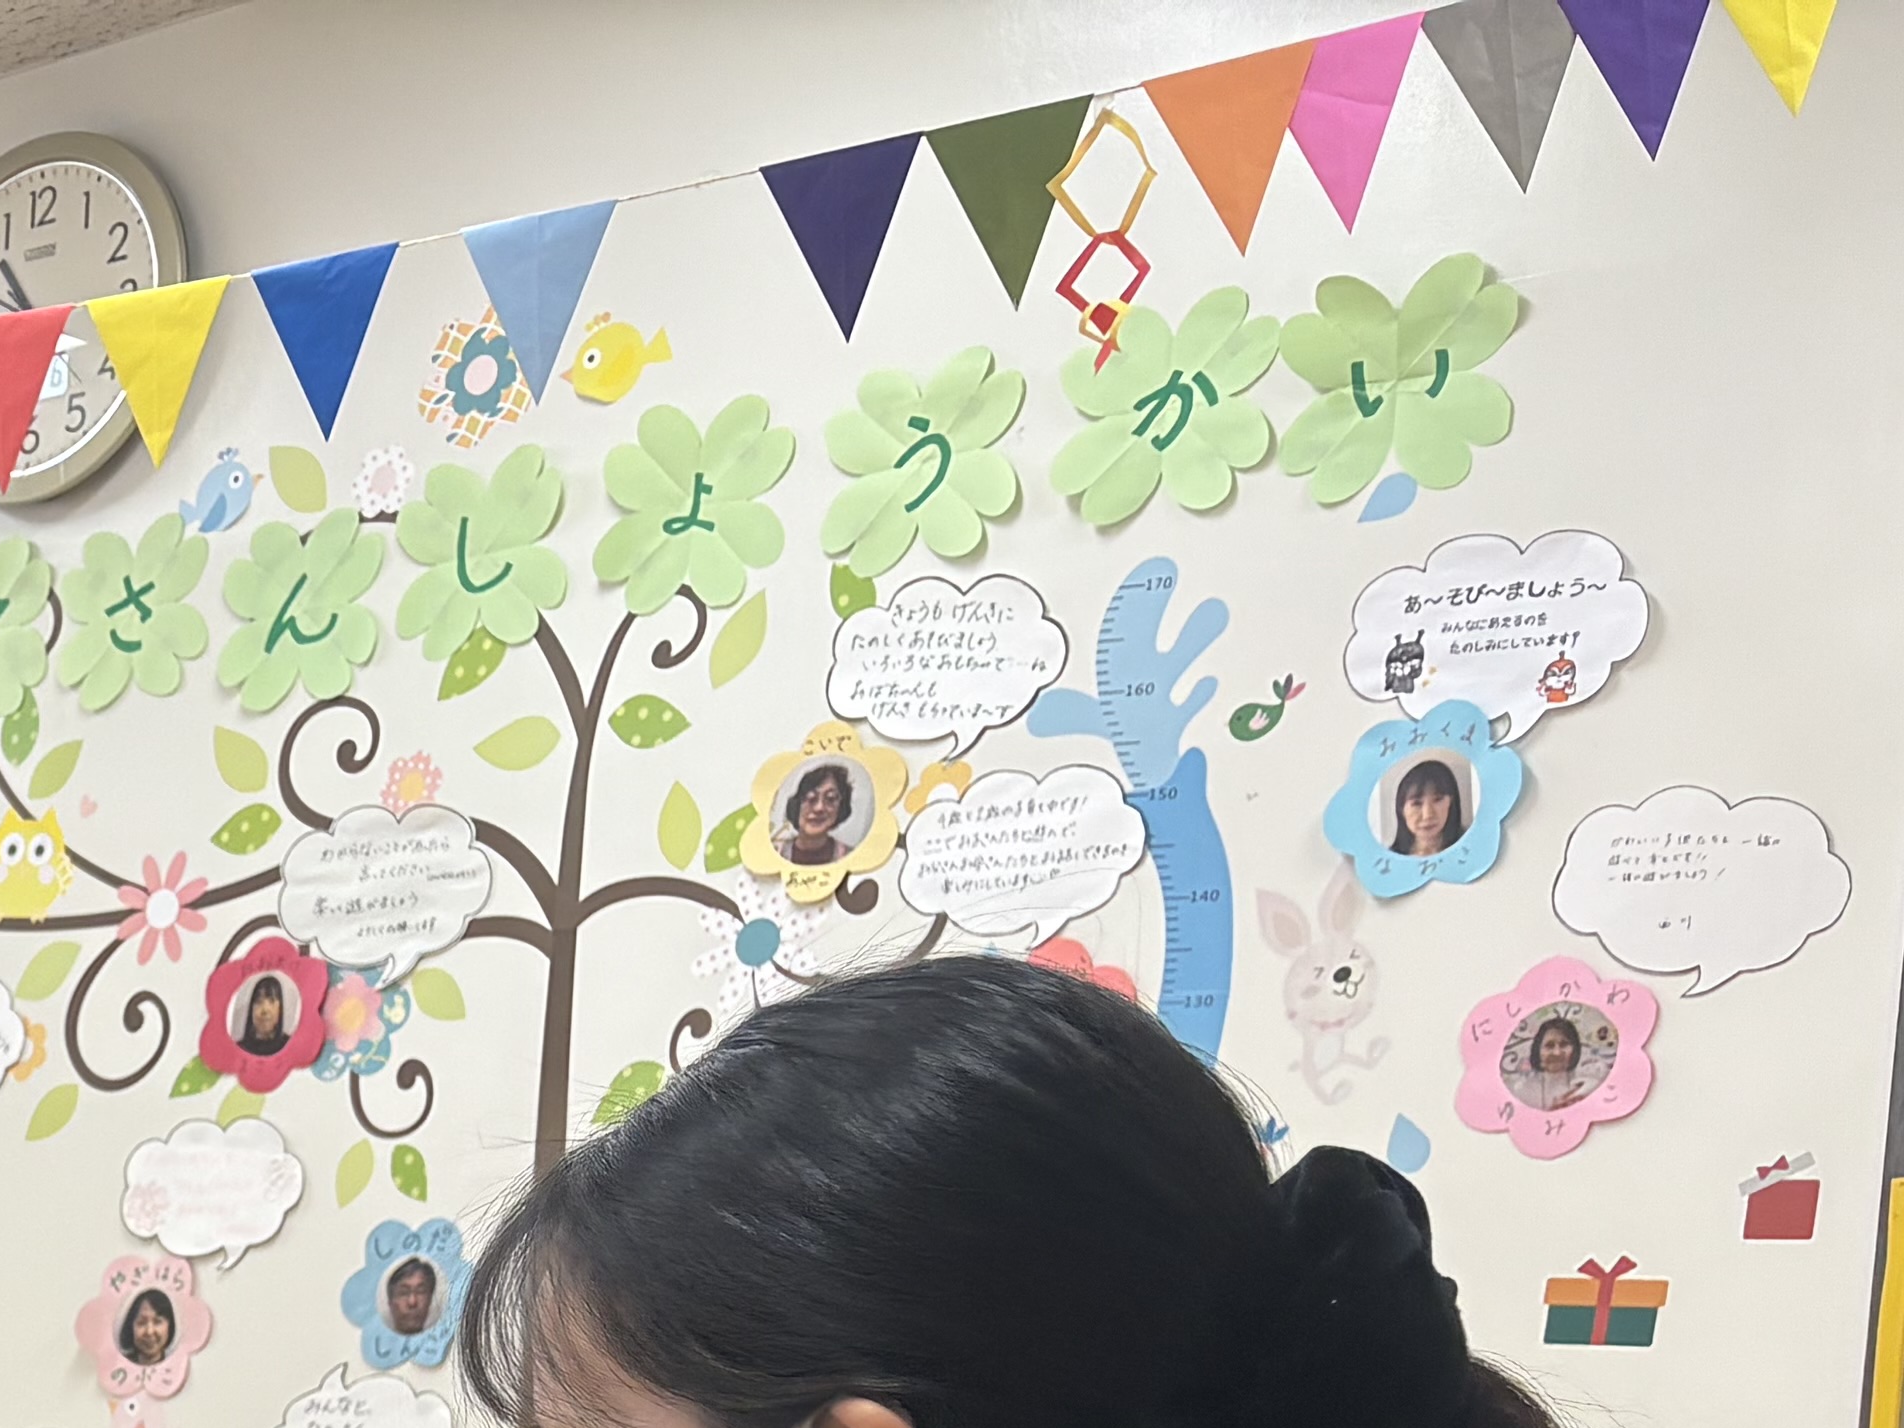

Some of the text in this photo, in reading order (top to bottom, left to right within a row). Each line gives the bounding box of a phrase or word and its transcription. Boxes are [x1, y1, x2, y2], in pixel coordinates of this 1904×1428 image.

[30, 185, 57, 229] 12
[83, 190, 91, 229] 1
[106, 221, 128, 264] 2
[64, 391, 87, 434] 5
[1145, 577, 1174, 591] 170
[1125, 682, 1156, 697] 160
[1149, 787, 1178, 801] 150
[1190, 888, 1221, 904] 140
[1183, 994, 1215, 1009] 130
